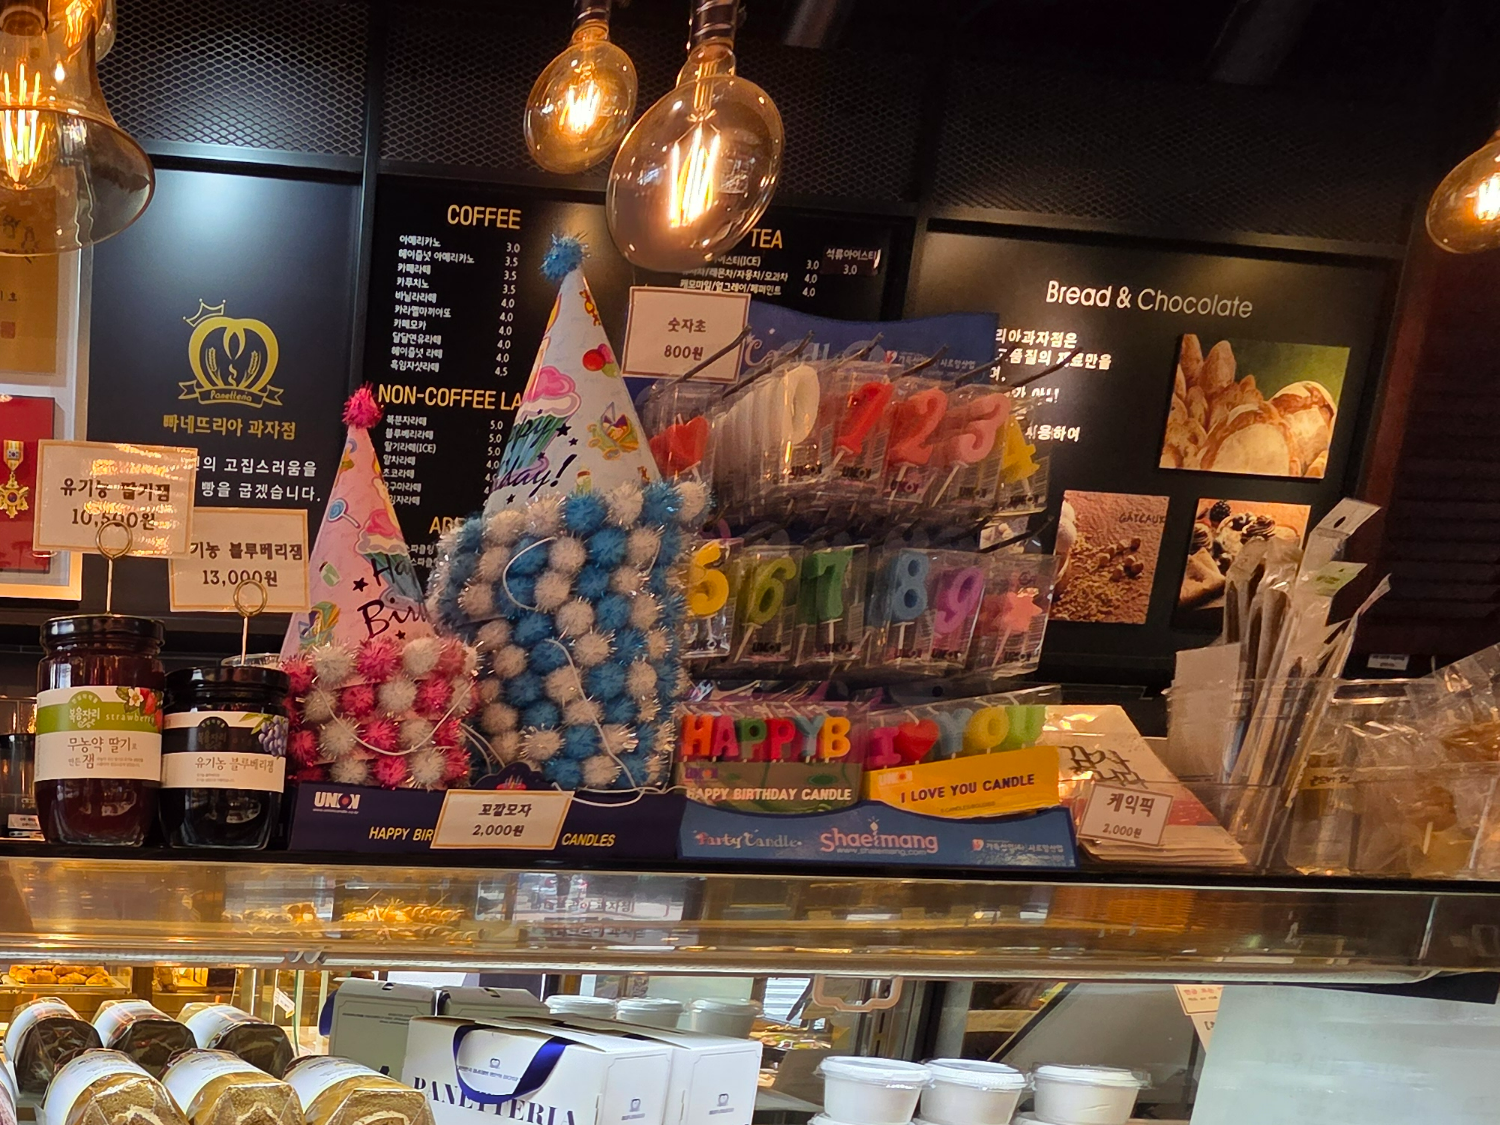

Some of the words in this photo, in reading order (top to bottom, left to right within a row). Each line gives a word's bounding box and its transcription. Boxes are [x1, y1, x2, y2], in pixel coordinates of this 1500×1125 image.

[447, 204, 522, 230] COFFEE
[399, 234, 442, 248] 아메리카노
[506, 242, 521, 253] 3.0
[750, 228, 783, 248] TEA
[398, 248, 432, 262] 헤이즐넛
[433, 250, 475, 264] 아메리카노
[504, 257, 519, 267] 3.5
[806, 260, 819, 270] 3.0
[397, 262, 431, 275] 카페라떼
[503, 271, 517, 281] 3.5
[843, 265, 857, 275] 3.0
[396, 277, 429, 289] 카푸치노
[502, 285, 516, 295] 3.5
[804, 274, 818, 284] 4.0
[394, 291, 437, 303] 바닐라라떼
[500, 298, 515, 308] 4.0
[802, 286, 816, 297] 4.0
[1045, 280, 1112, 308] Bread
[1116, 286, 1132, 309] &
[1137, 287, 1253, 319] Chocolate
[499, 312, 514, 322] 4.0
[668, 316, 706, 333] 숫자초
[393, 319, 426, 331] 카페모카
[498, 326, 513, 336] 4.0
[496, 340, 511, 349] 4.0
[664, 345, 703, 361] 800원
[391, 346, 424, 358] 헤이즐넛
[426, 348, 443, 359] 라떼
[495, 353, 510, 363] 4.0
[494, 367, 508, 377] 4.5
[211, 390, 252, 402] Panetteria
[378, 384, 496, 409] NON-COFFEE
[163, 414, 243, 437] 빠네뜨리아
[248, 420, 296, 440] 과자점
[490, 420, 503, 430] 5.0
[385, 428, 434, 440] 블루베리라떼
[489, 434, 502, 444] 5.0
[487, 447, 501, 457] 5.0
[224, 458, 317, 477] 고집스러움을
[486, 461, 499, 470] 4.0
[60, 478, 111, 498] 유기농
[201, 481, 231, 498] 빵을
[238, 483, 321, 502] 굽겠습니다.
[71, 511, 156, 531] 10,500원
[229, 542, 303, 561] 블루베리잼
[202, 570, 278, 587] 13,000원
[68, 707, 100, 721] 복음자리
[67, 736, 105, 752] 무농약
[82, 753, 94, 770] 잼
[194, 756, 226, 772] 유기농
[229, 757, 275, 774] 블루베리잼
[686, 787, 730, 801] HAPPY
[733, 788, 798, 801] BIRTHDAY
[801, 788, 852, 801] CANDLE
[901, 792, 905, 803] I
[911, 786, 945, 802] LOVE
[950, 781, 977, 797] YOU
[982, 773, 1035, 792] CANDLE
[478, 803, 532, 817] 꼬깔모자
[1106, 793, 1155, 817] 케익픽
[368, 826, 410, 841] HAPPY
[561, 832, 616, 847] CANDLES
[472, 824, 524, 838] 2,000원
[1102, 823, 1142, 839] 2,000원
